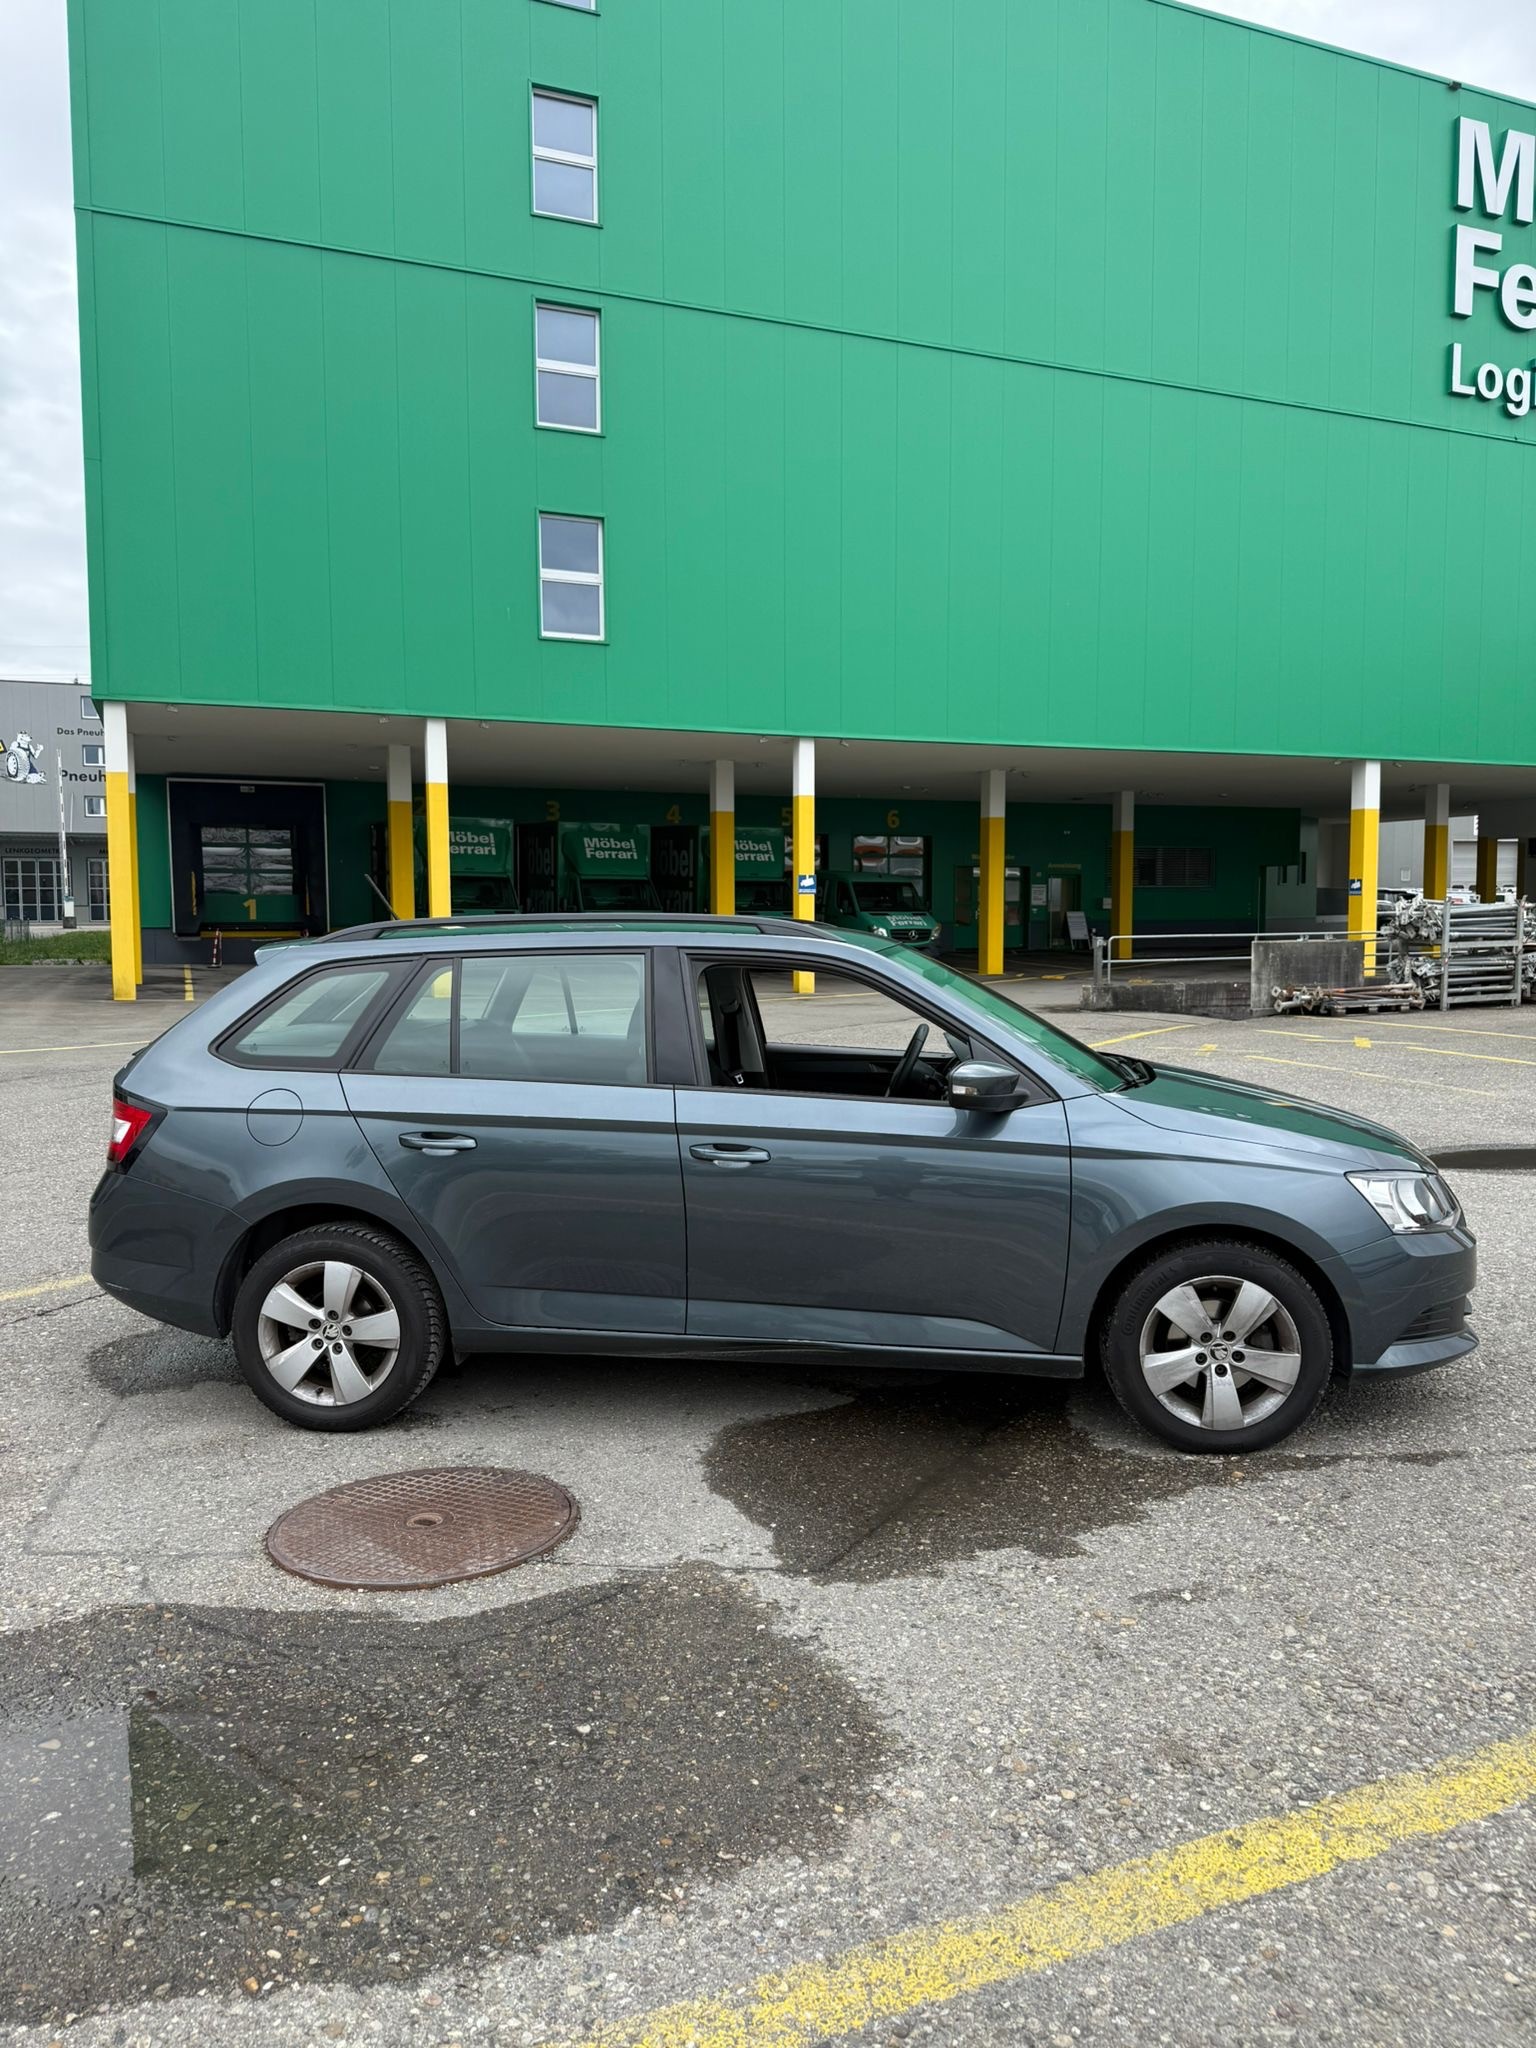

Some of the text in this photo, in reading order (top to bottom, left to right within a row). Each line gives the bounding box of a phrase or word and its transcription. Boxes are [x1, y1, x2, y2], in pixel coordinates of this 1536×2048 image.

[1456, 115, 1535, 223] M
[1453, 223, 1536, 329] Fe
[1451, 342, 1536, 416] Log
[56, 727, 75, 736] Das
[61, 769, 106, 783] Pneuh
[546, 800, 560, 821] 3
[665, 803, 683, 823] 4
[781, 807, 792, 827] 5
[887, 809, 900, 829] 6
[450, 843, 497, 856] errari
[583, 837, 636, 850] Möbel
[585, 848, 638, 861] Ferrari
[656, 838, 694, 878] öbel
[735, 851, 776, 862] errari
[242, 897, 257, 921] 1
